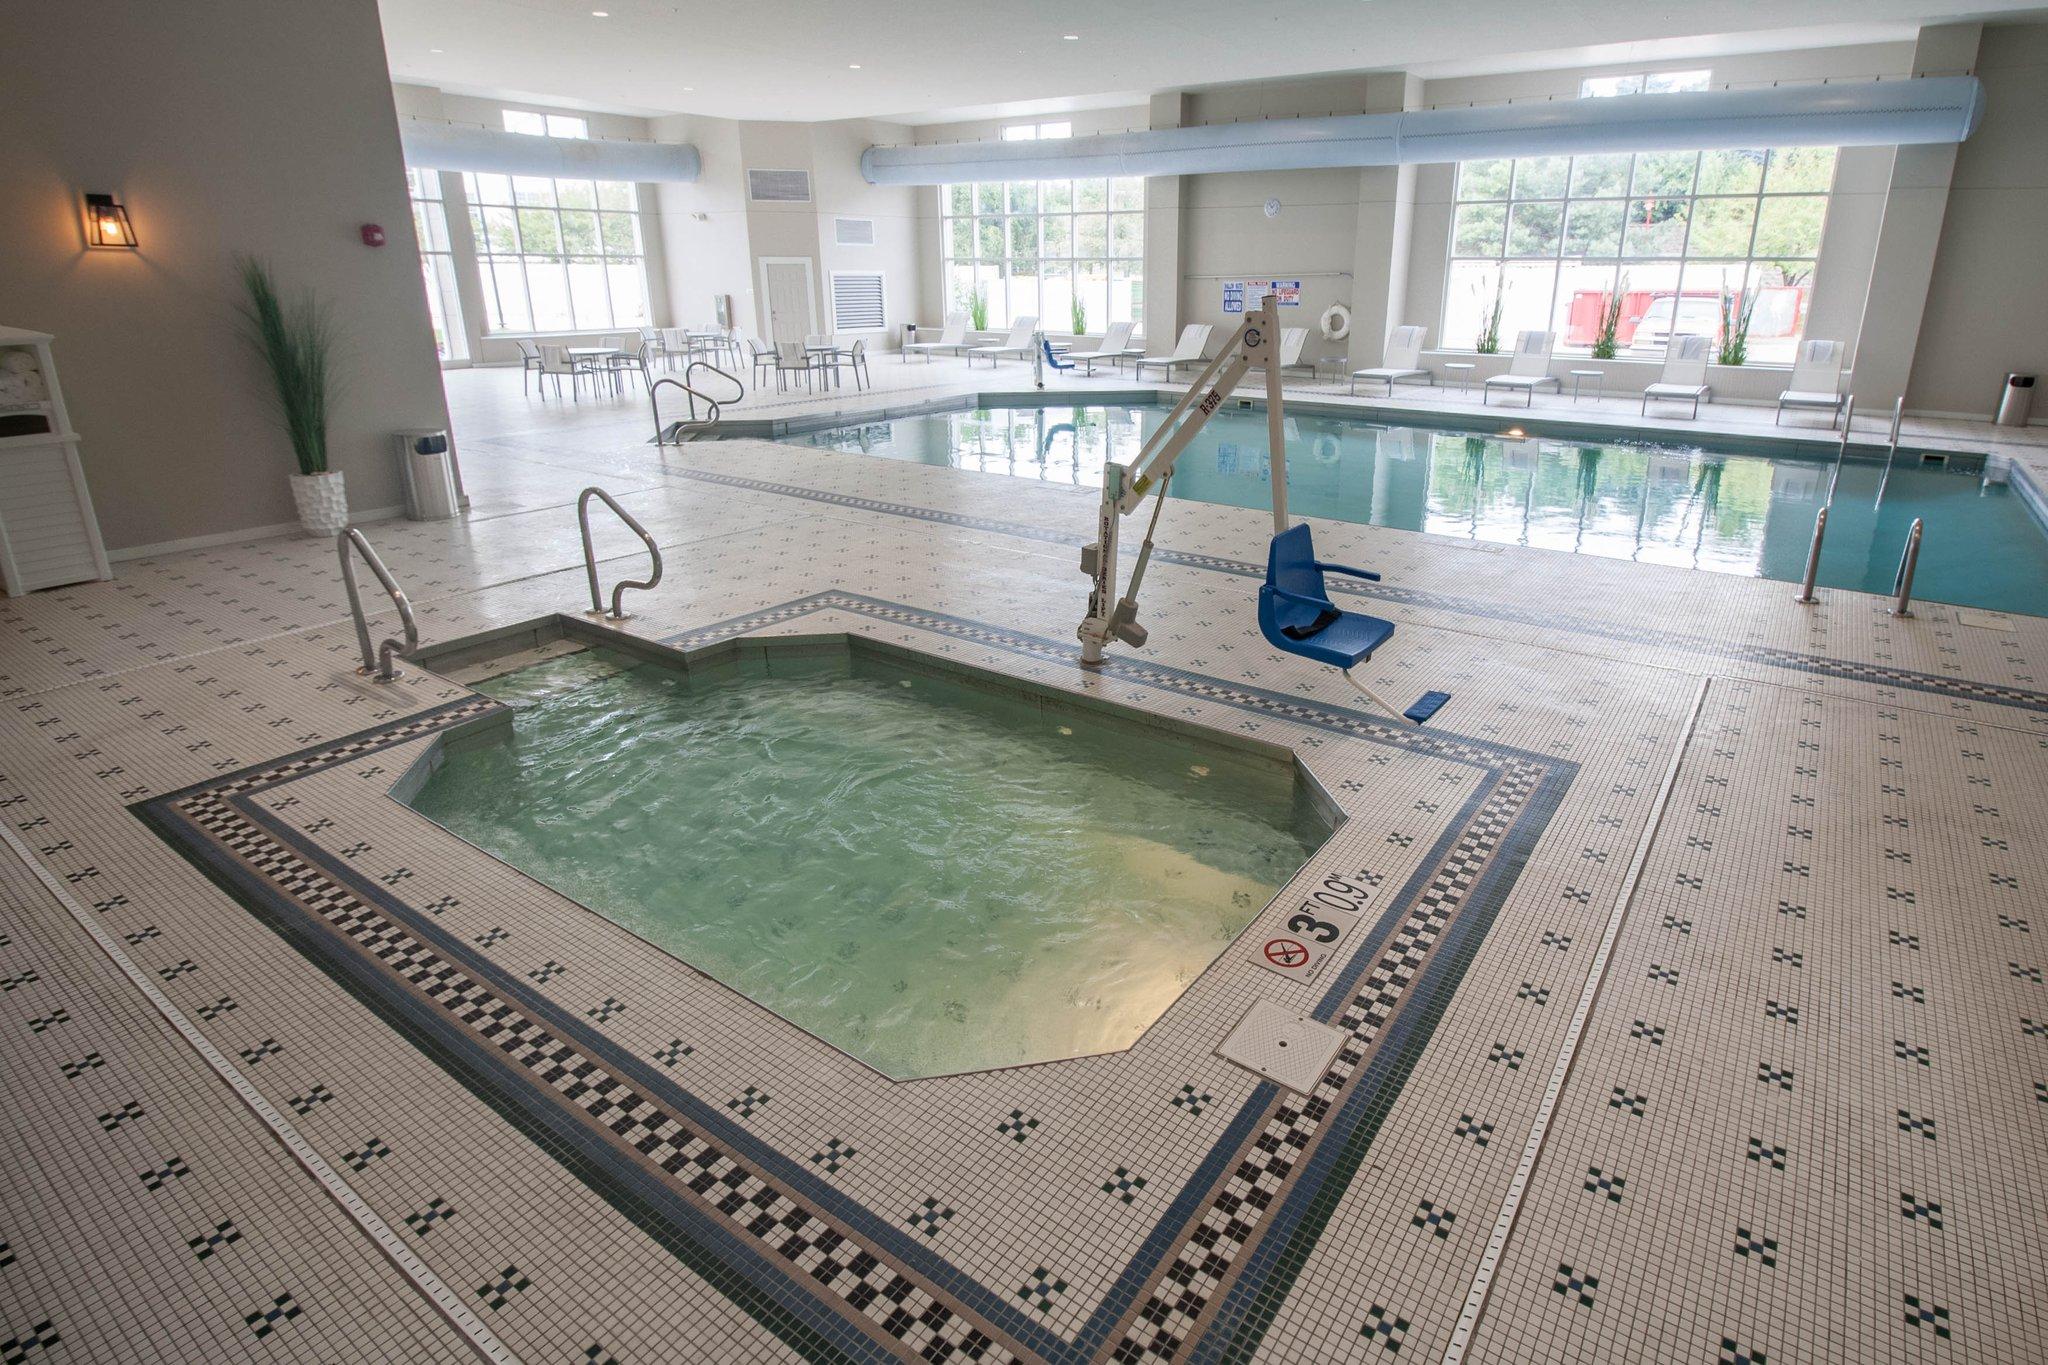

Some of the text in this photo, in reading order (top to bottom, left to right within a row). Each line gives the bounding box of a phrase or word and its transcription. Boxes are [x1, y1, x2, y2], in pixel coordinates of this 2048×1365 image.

[1224, 301, 1241, 311] ALLOWED
[1299, 900, 1320, 916] FT
[1287, 914, 1340, 943] 3
[1305, 953, 1327, 978] NO DIVING
